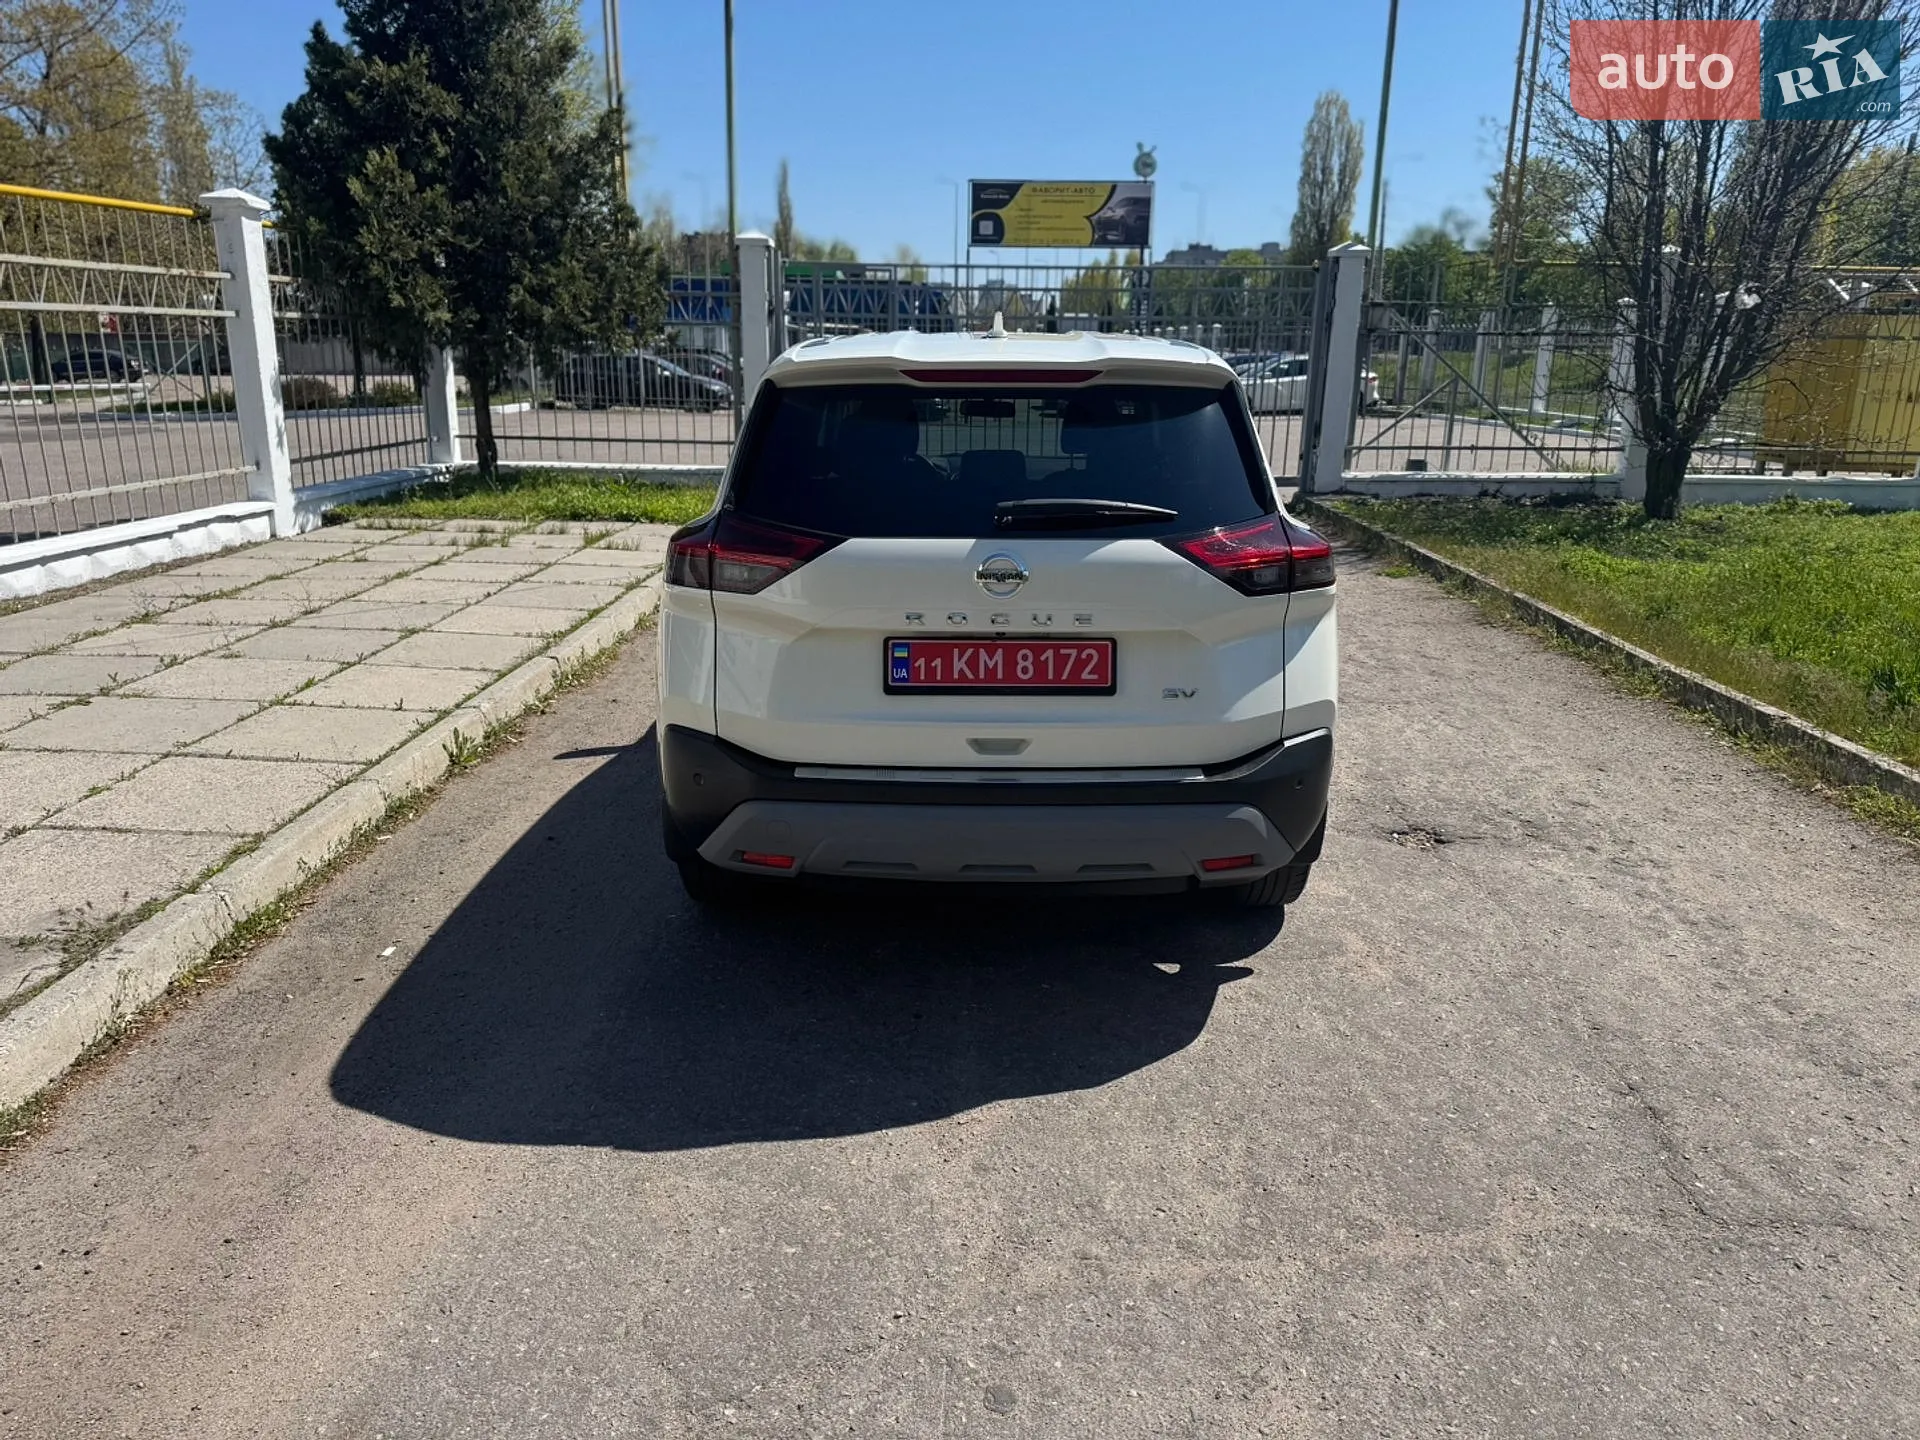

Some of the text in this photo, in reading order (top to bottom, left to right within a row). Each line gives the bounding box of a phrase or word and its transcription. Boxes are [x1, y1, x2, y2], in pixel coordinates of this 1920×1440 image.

[976, 570, 1024, 582] NISSAN
[904, 611, 1093, 628] ROGUE
[914, 648, 1099, 680] 11 KM 8172
[893, 668, 908, 679] UA
[1162, 687, 1199, 699] SV
